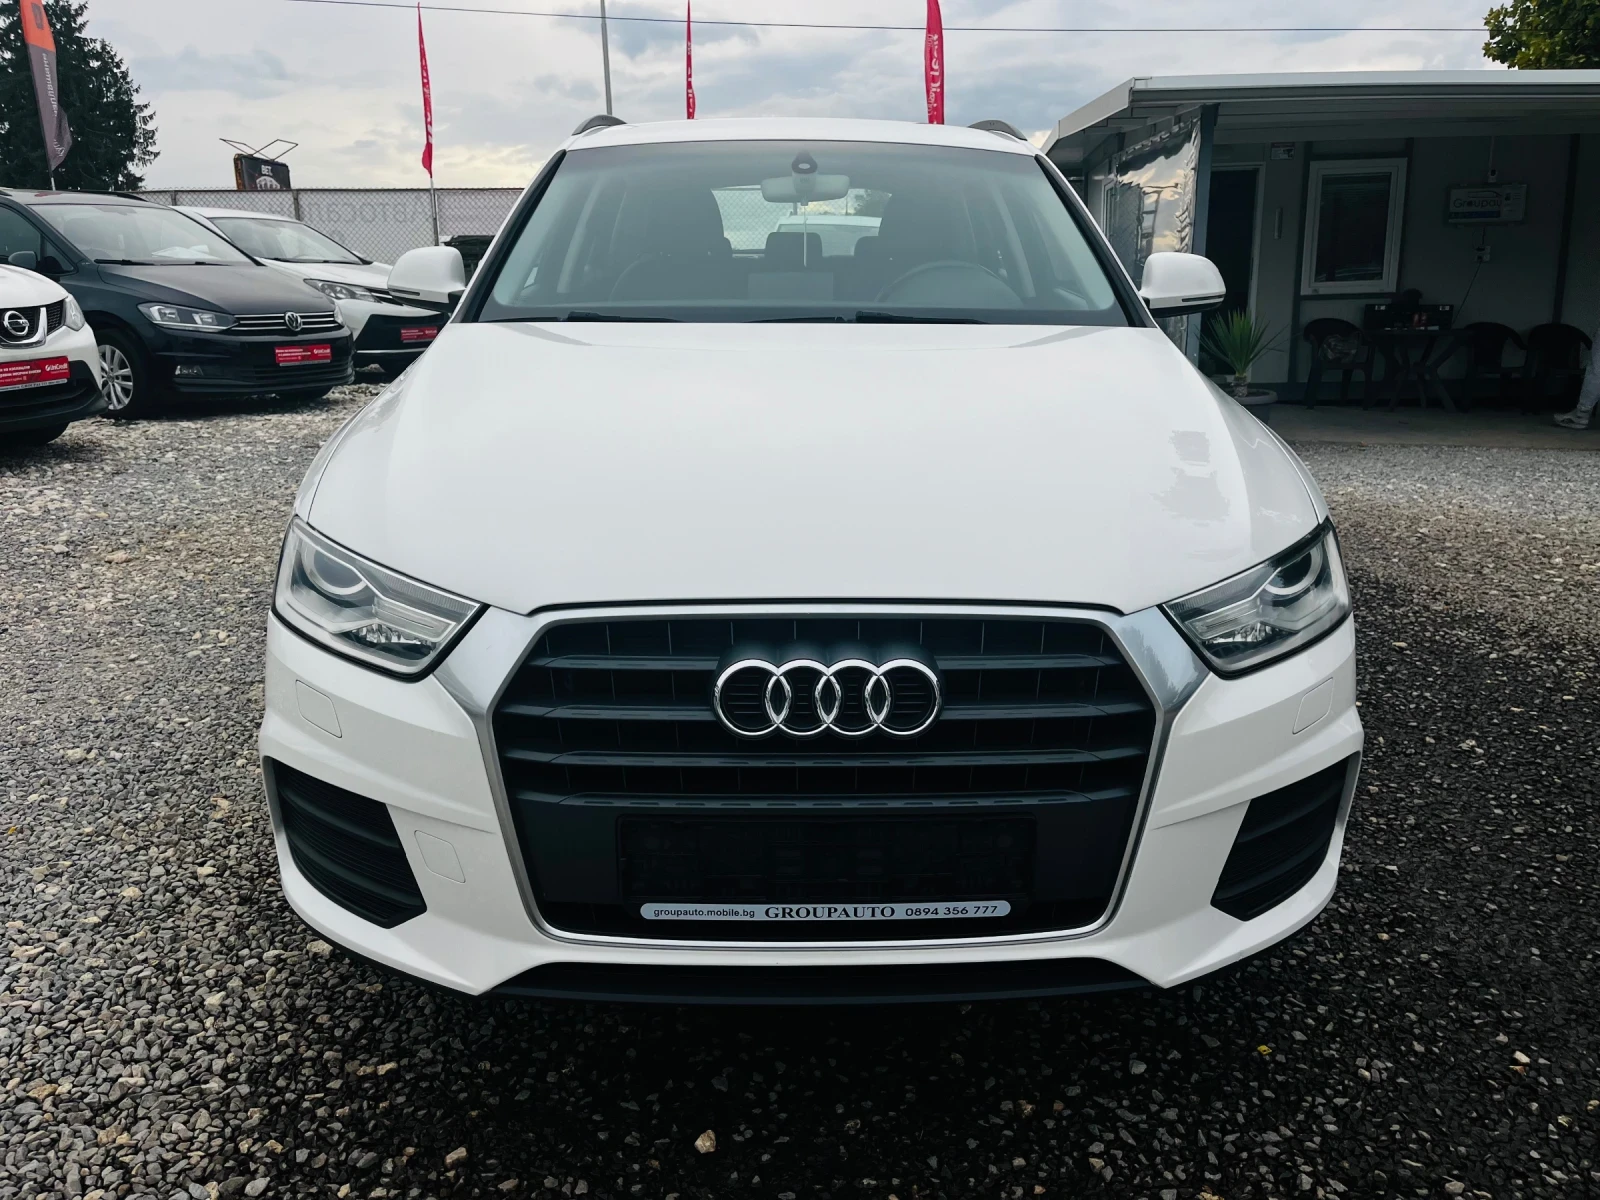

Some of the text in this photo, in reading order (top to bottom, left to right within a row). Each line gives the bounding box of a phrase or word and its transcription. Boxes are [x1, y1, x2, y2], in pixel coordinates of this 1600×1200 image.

[50, 363, 68, 371] UniCredit
[653, 905, 998, 919] groupauto.mobile.bg GROUPAUTO 0894 356 777
